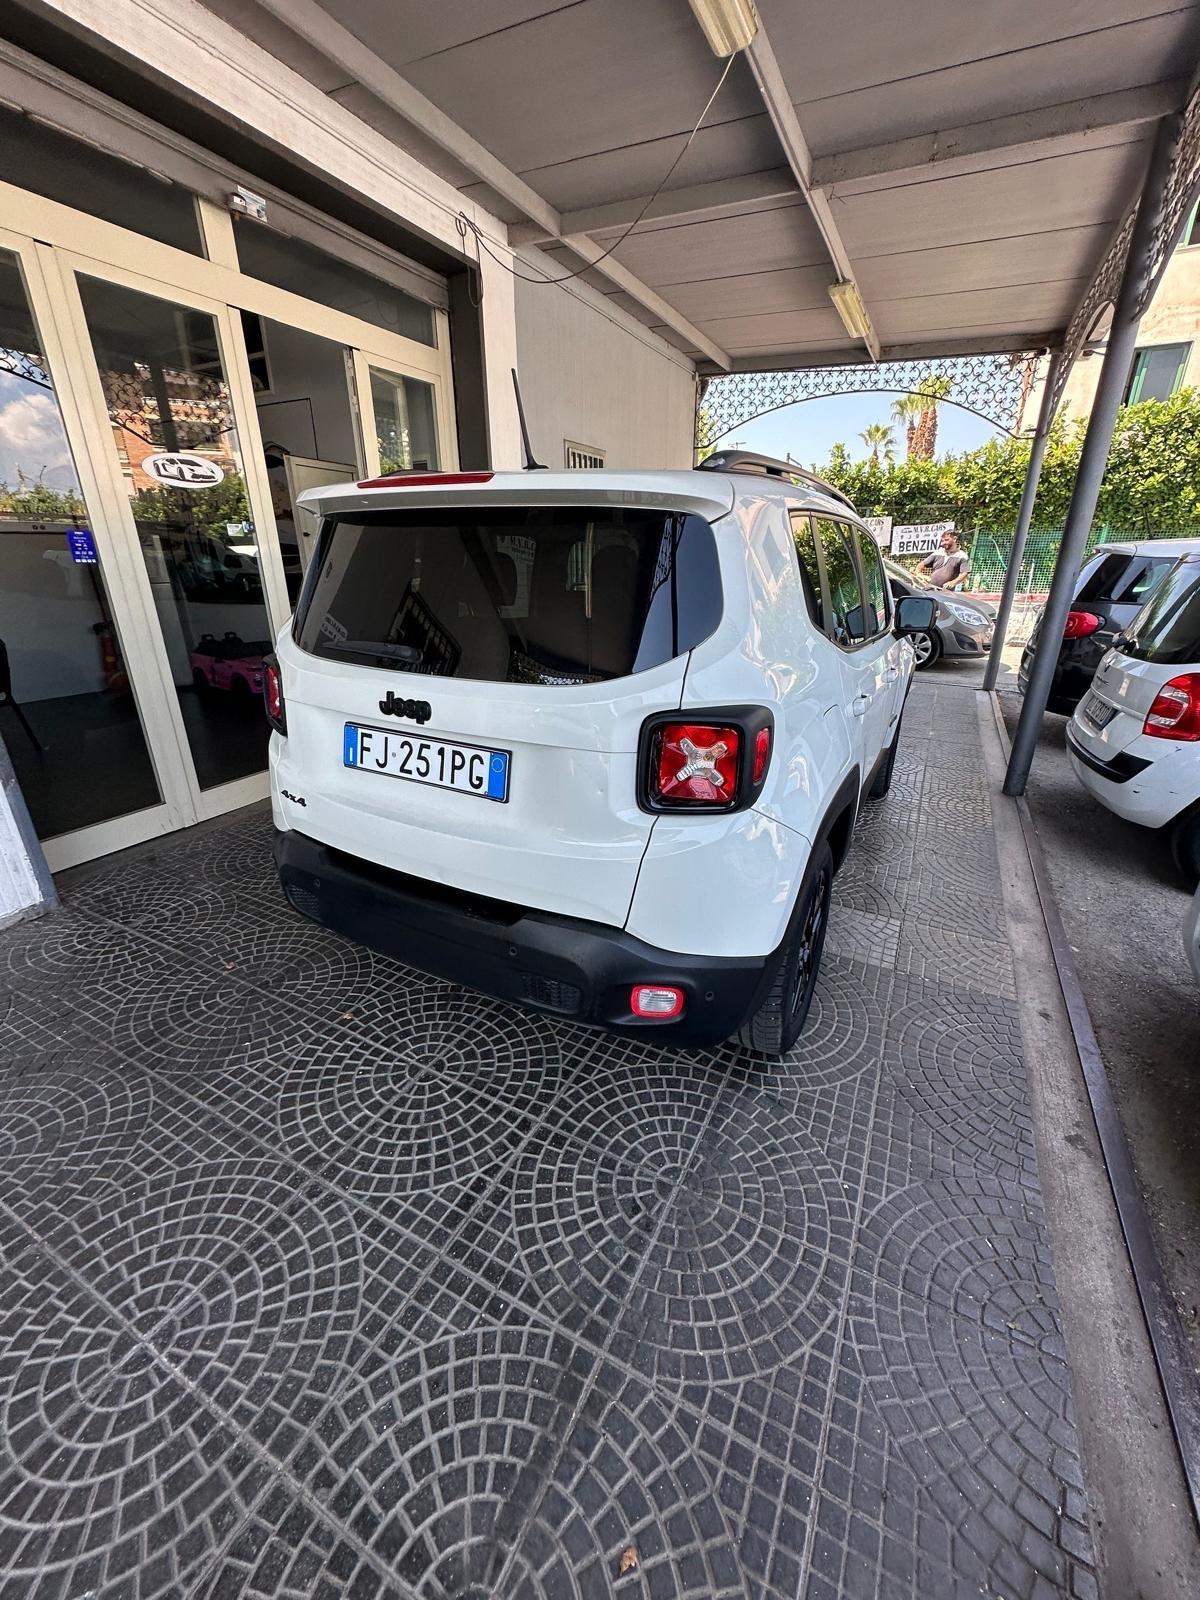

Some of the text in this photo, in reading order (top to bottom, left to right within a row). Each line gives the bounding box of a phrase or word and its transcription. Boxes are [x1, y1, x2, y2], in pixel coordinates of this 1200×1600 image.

[379, 691, 432, 725] Jeep
[360, 732, 389, 769] FJ
[399, 740, 485, 790] 251PG
[281, 789, 307, 808] 4x4
